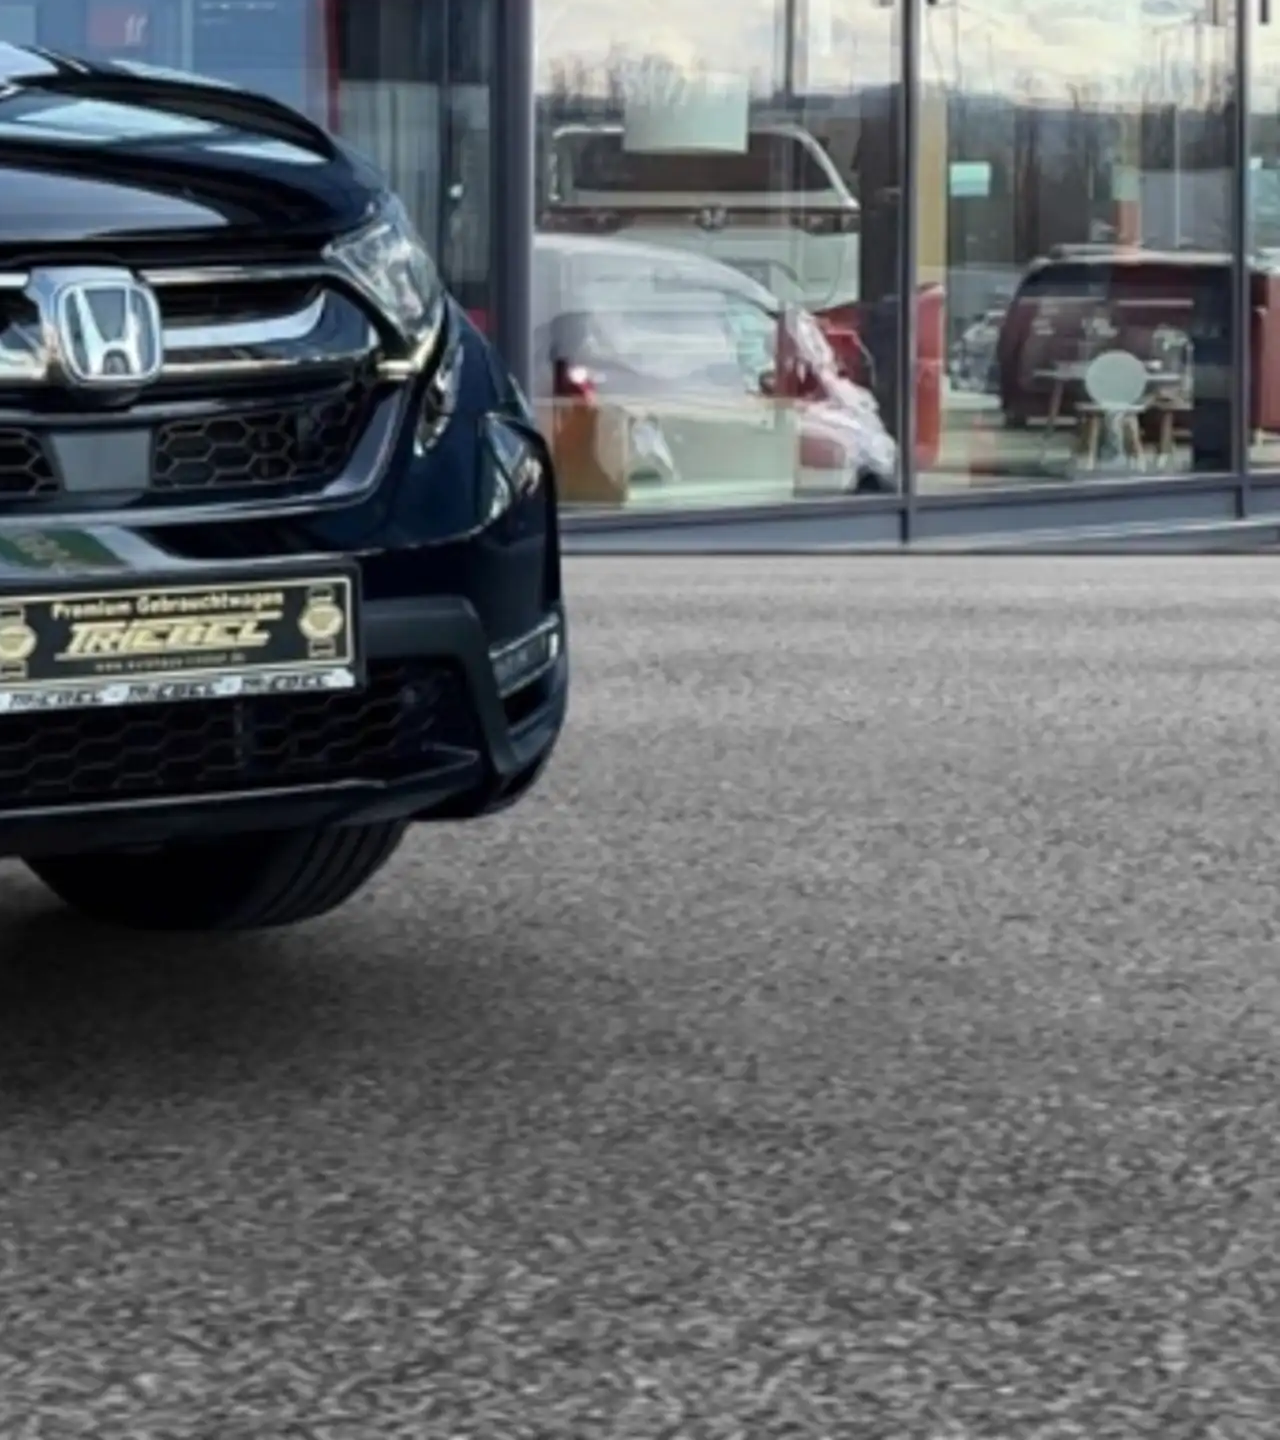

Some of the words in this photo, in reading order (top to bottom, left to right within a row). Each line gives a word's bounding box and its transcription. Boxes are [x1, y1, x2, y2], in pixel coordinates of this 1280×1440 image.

[51, 599, 132, 621] Premium
[136, 591, 285, 614] Gebrauchtwagen
[54, 610, 283, 661] TRIEBEL
